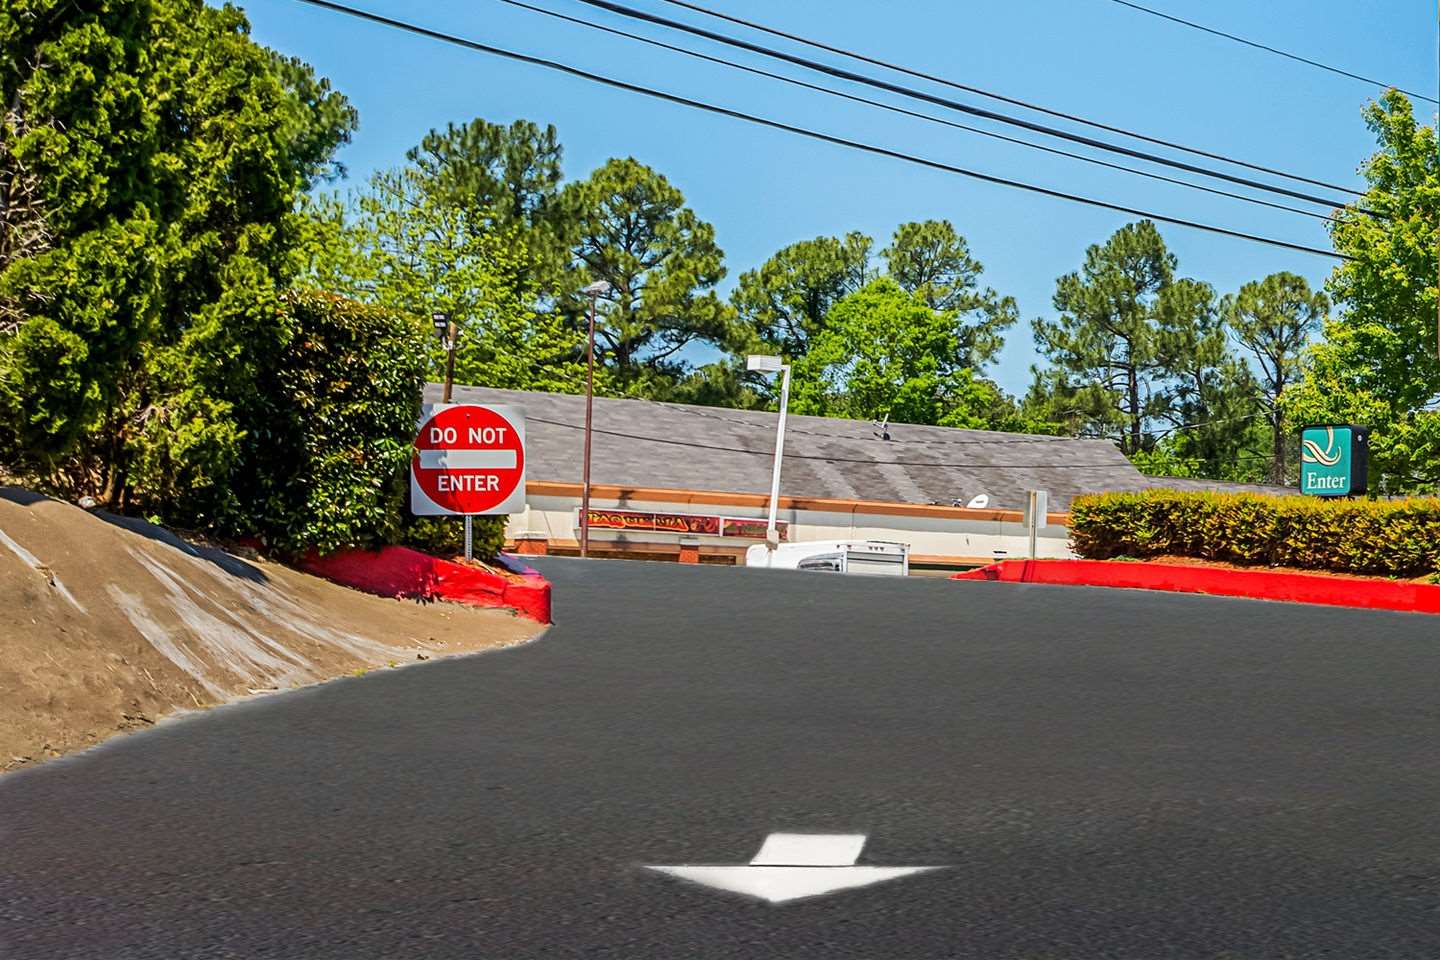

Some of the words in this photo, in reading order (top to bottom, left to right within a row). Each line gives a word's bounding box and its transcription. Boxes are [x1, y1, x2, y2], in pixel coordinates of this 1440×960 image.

[430, 427, 457, 444] DO
[468, 427, 507, 444] NOT
[437, 474, 499, 492] ENTER
[1306, 472, 1346, 490] Enter
